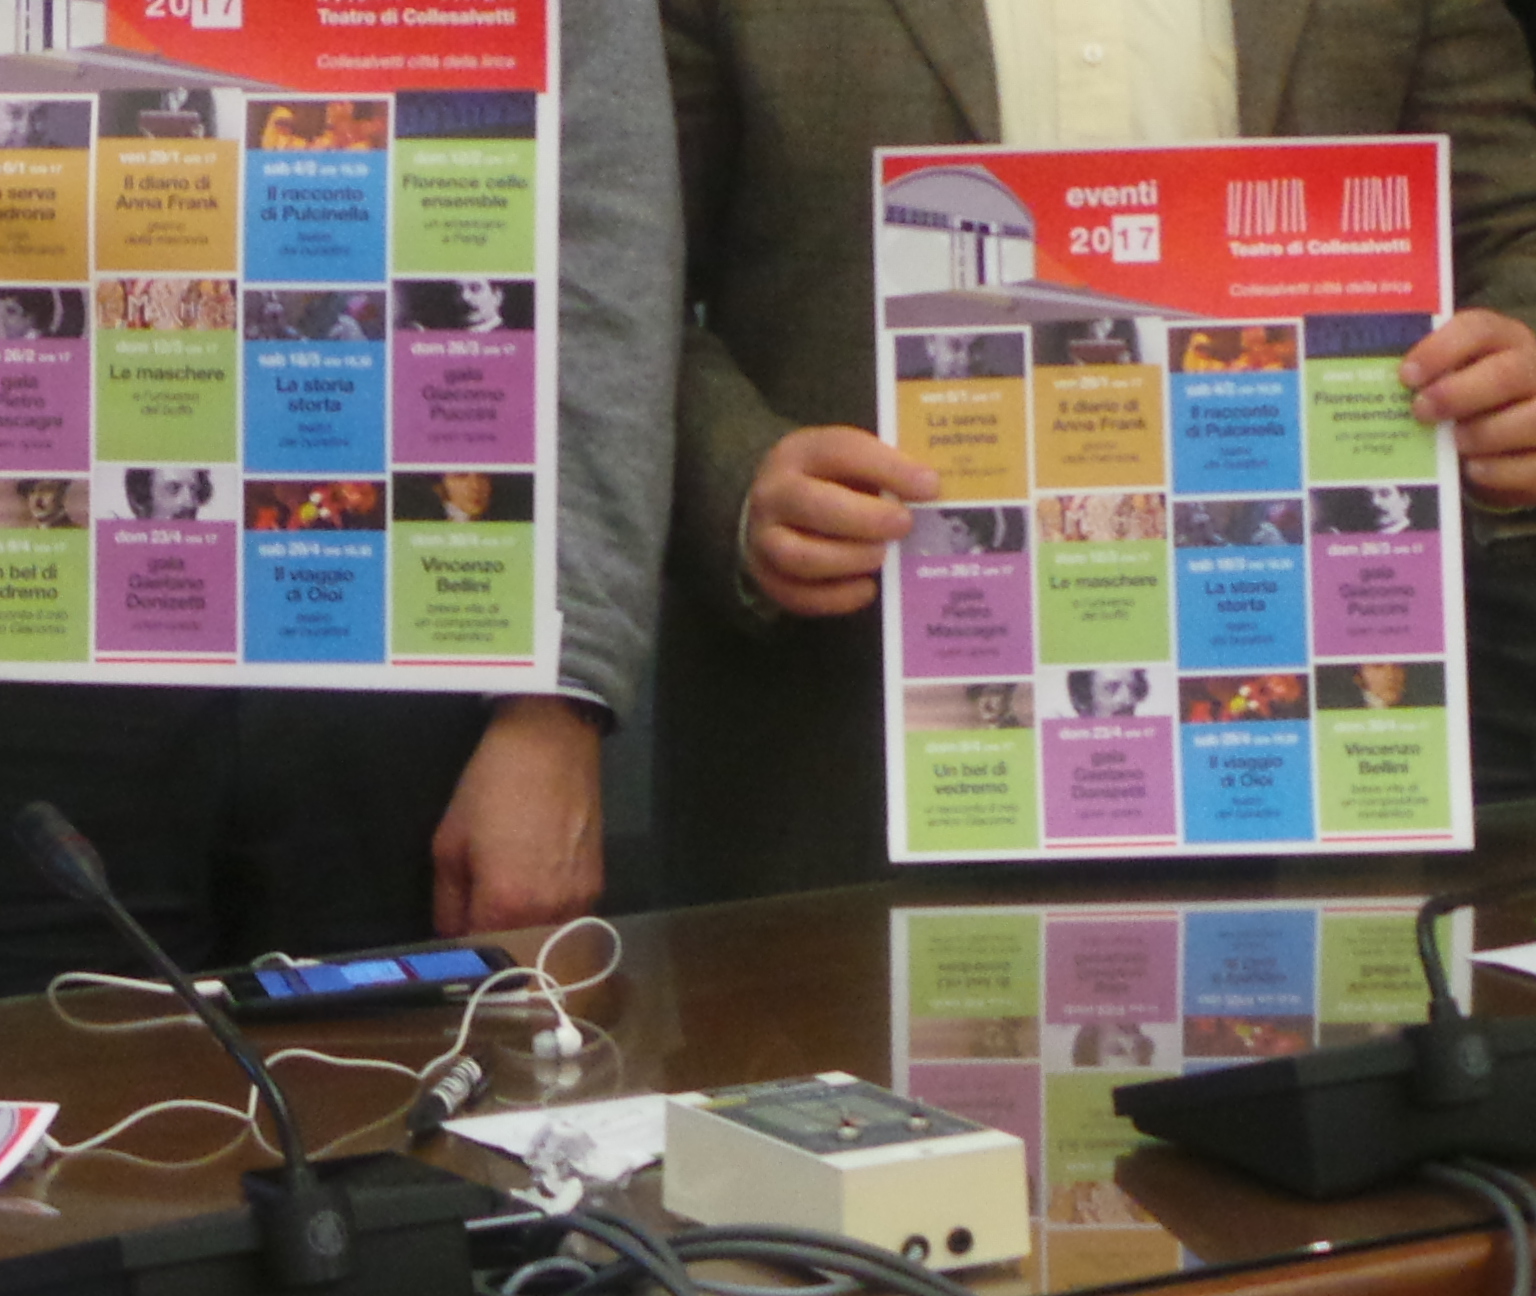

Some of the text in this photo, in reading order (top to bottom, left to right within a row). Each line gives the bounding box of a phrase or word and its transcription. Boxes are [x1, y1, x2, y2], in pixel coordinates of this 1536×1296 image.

[317, 6, 517, 27] Teatro di Collesalvetti
[317, 54, 403, 71] Collesalvetti
[119, 152, 147, 165] ven
[123, 174, 211, 191] Il diario di
[403, 172, 529, 190] Florence cello
[7, 186, 56, 200] serva
[267, 186, 364, 202] Il racconto
[1065, 179, 1158, 209] eventi
[116, 194, 218, 211] Anna Frank
[421, 195, 509, 209] ensemble
[260, 205, 370, 222] di Pulcinella
[1069, 227, 1155, 255] 2017
[1229, 237, 1412, 257] Teatro di Collesalvetti
[1229, 282, 1310, 297] Collesalvetti
[109, 364, 225, 381] Le maschere
[276, 376, 355, 393] La storia
[288, 397, 342, 413] storta
[115, 530, 148, 544] dom
[9, 563, 37, 580] bel
[41, 563, 58, 580] di
[420, 557, 506, 574] Vincenzo
[274, 566, 355, 585] Il viaggio
[1050, 574, 1158, 590] Le maschere
[436, 576, 491, 594] Bellini
[1204, 581, 1226, 595] La
[286, 587, 302, 602] di
[933, 763, 958, 778] Un
